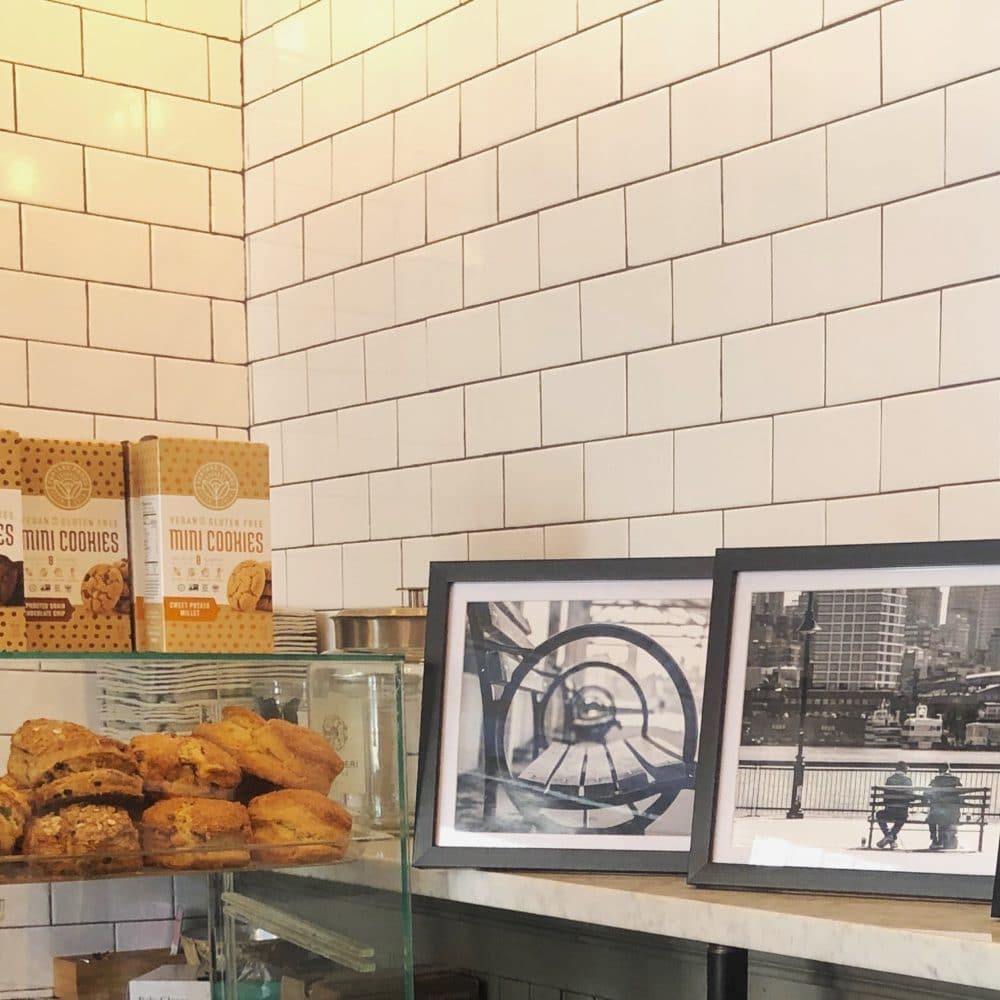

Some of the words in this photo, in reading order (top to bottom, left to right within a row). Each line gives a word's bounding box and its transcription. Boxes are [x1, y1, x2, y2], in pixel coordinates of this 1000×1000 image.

[22, 529, 55, 552] MINI
[60, 530, 119, 553] COOKIES
[168, 528, 202, 552] MINI
[207, 530, 264, 553] COOKIES
